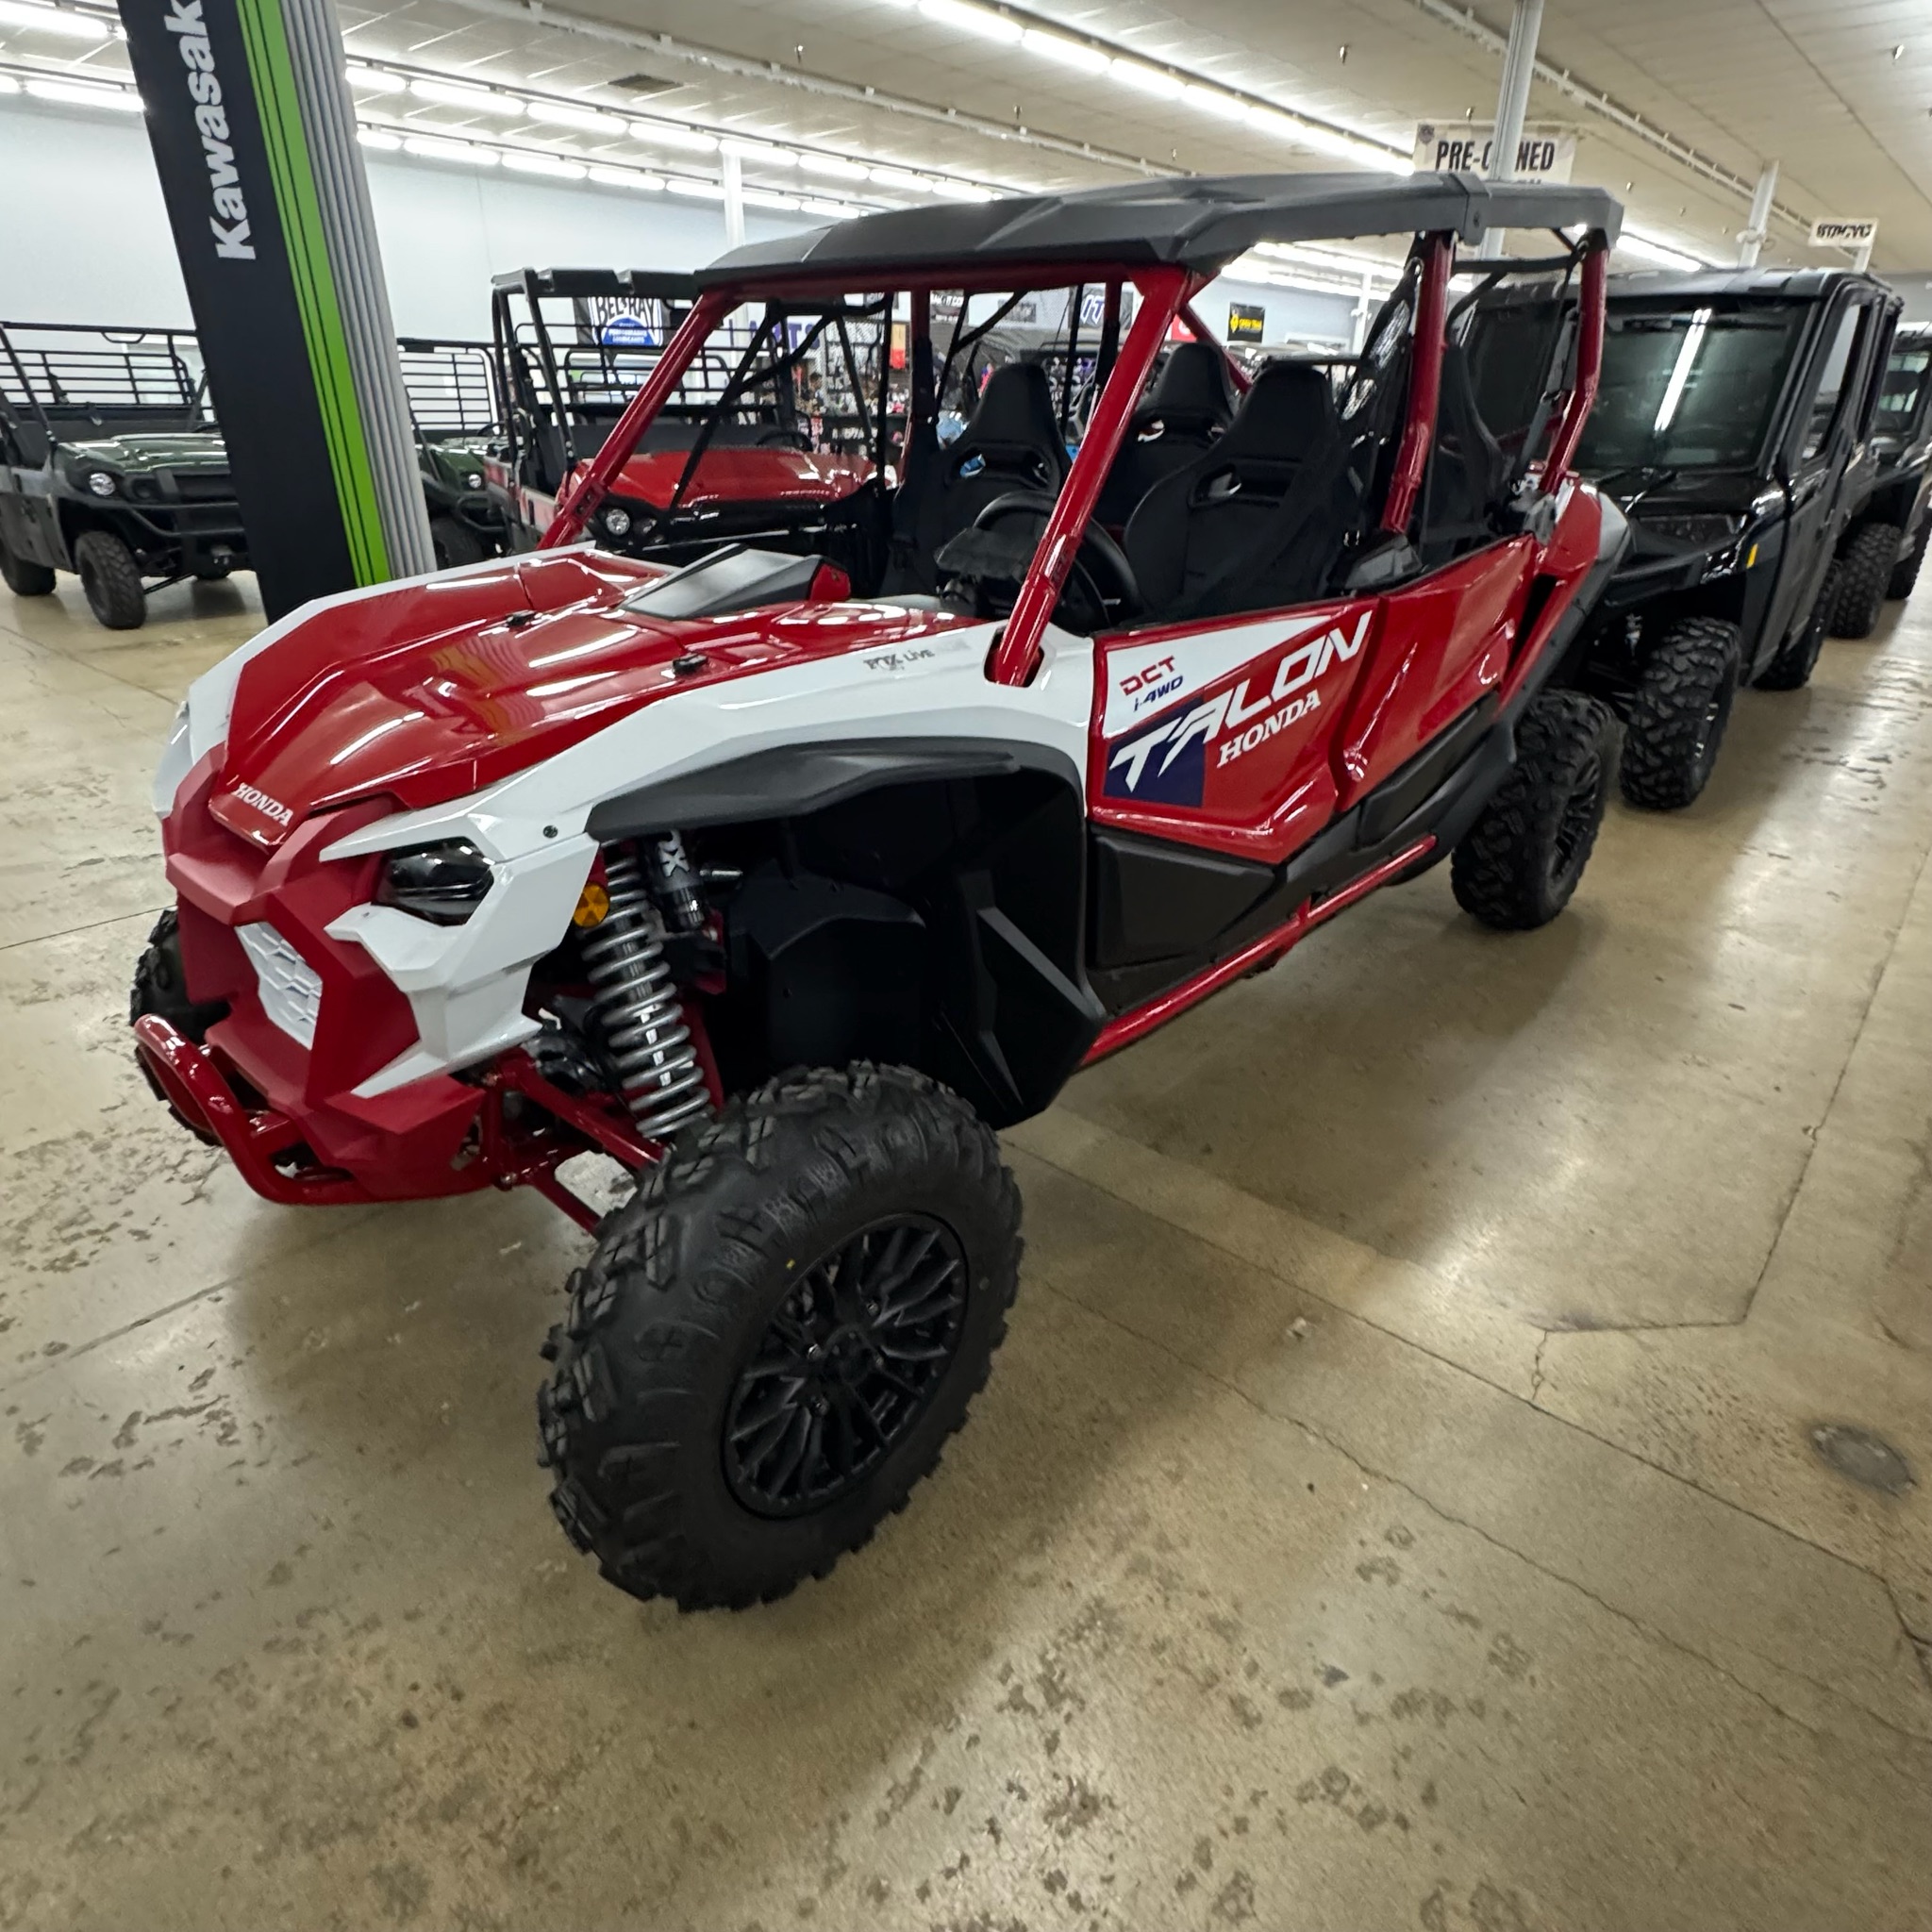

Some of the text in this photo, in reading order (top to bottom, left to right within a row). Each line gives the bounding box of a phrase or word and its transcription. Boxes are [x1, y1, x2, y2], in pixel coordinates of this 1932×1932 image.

[1436, 140, 1555, 171] PRE-NED
[1119, 656, 1175, 696] DCT
[1108, 609, 1373, 793] TALON
[1216, 690, 1323, 769] HONDA
[231, 782, 293, 826] HONDA
